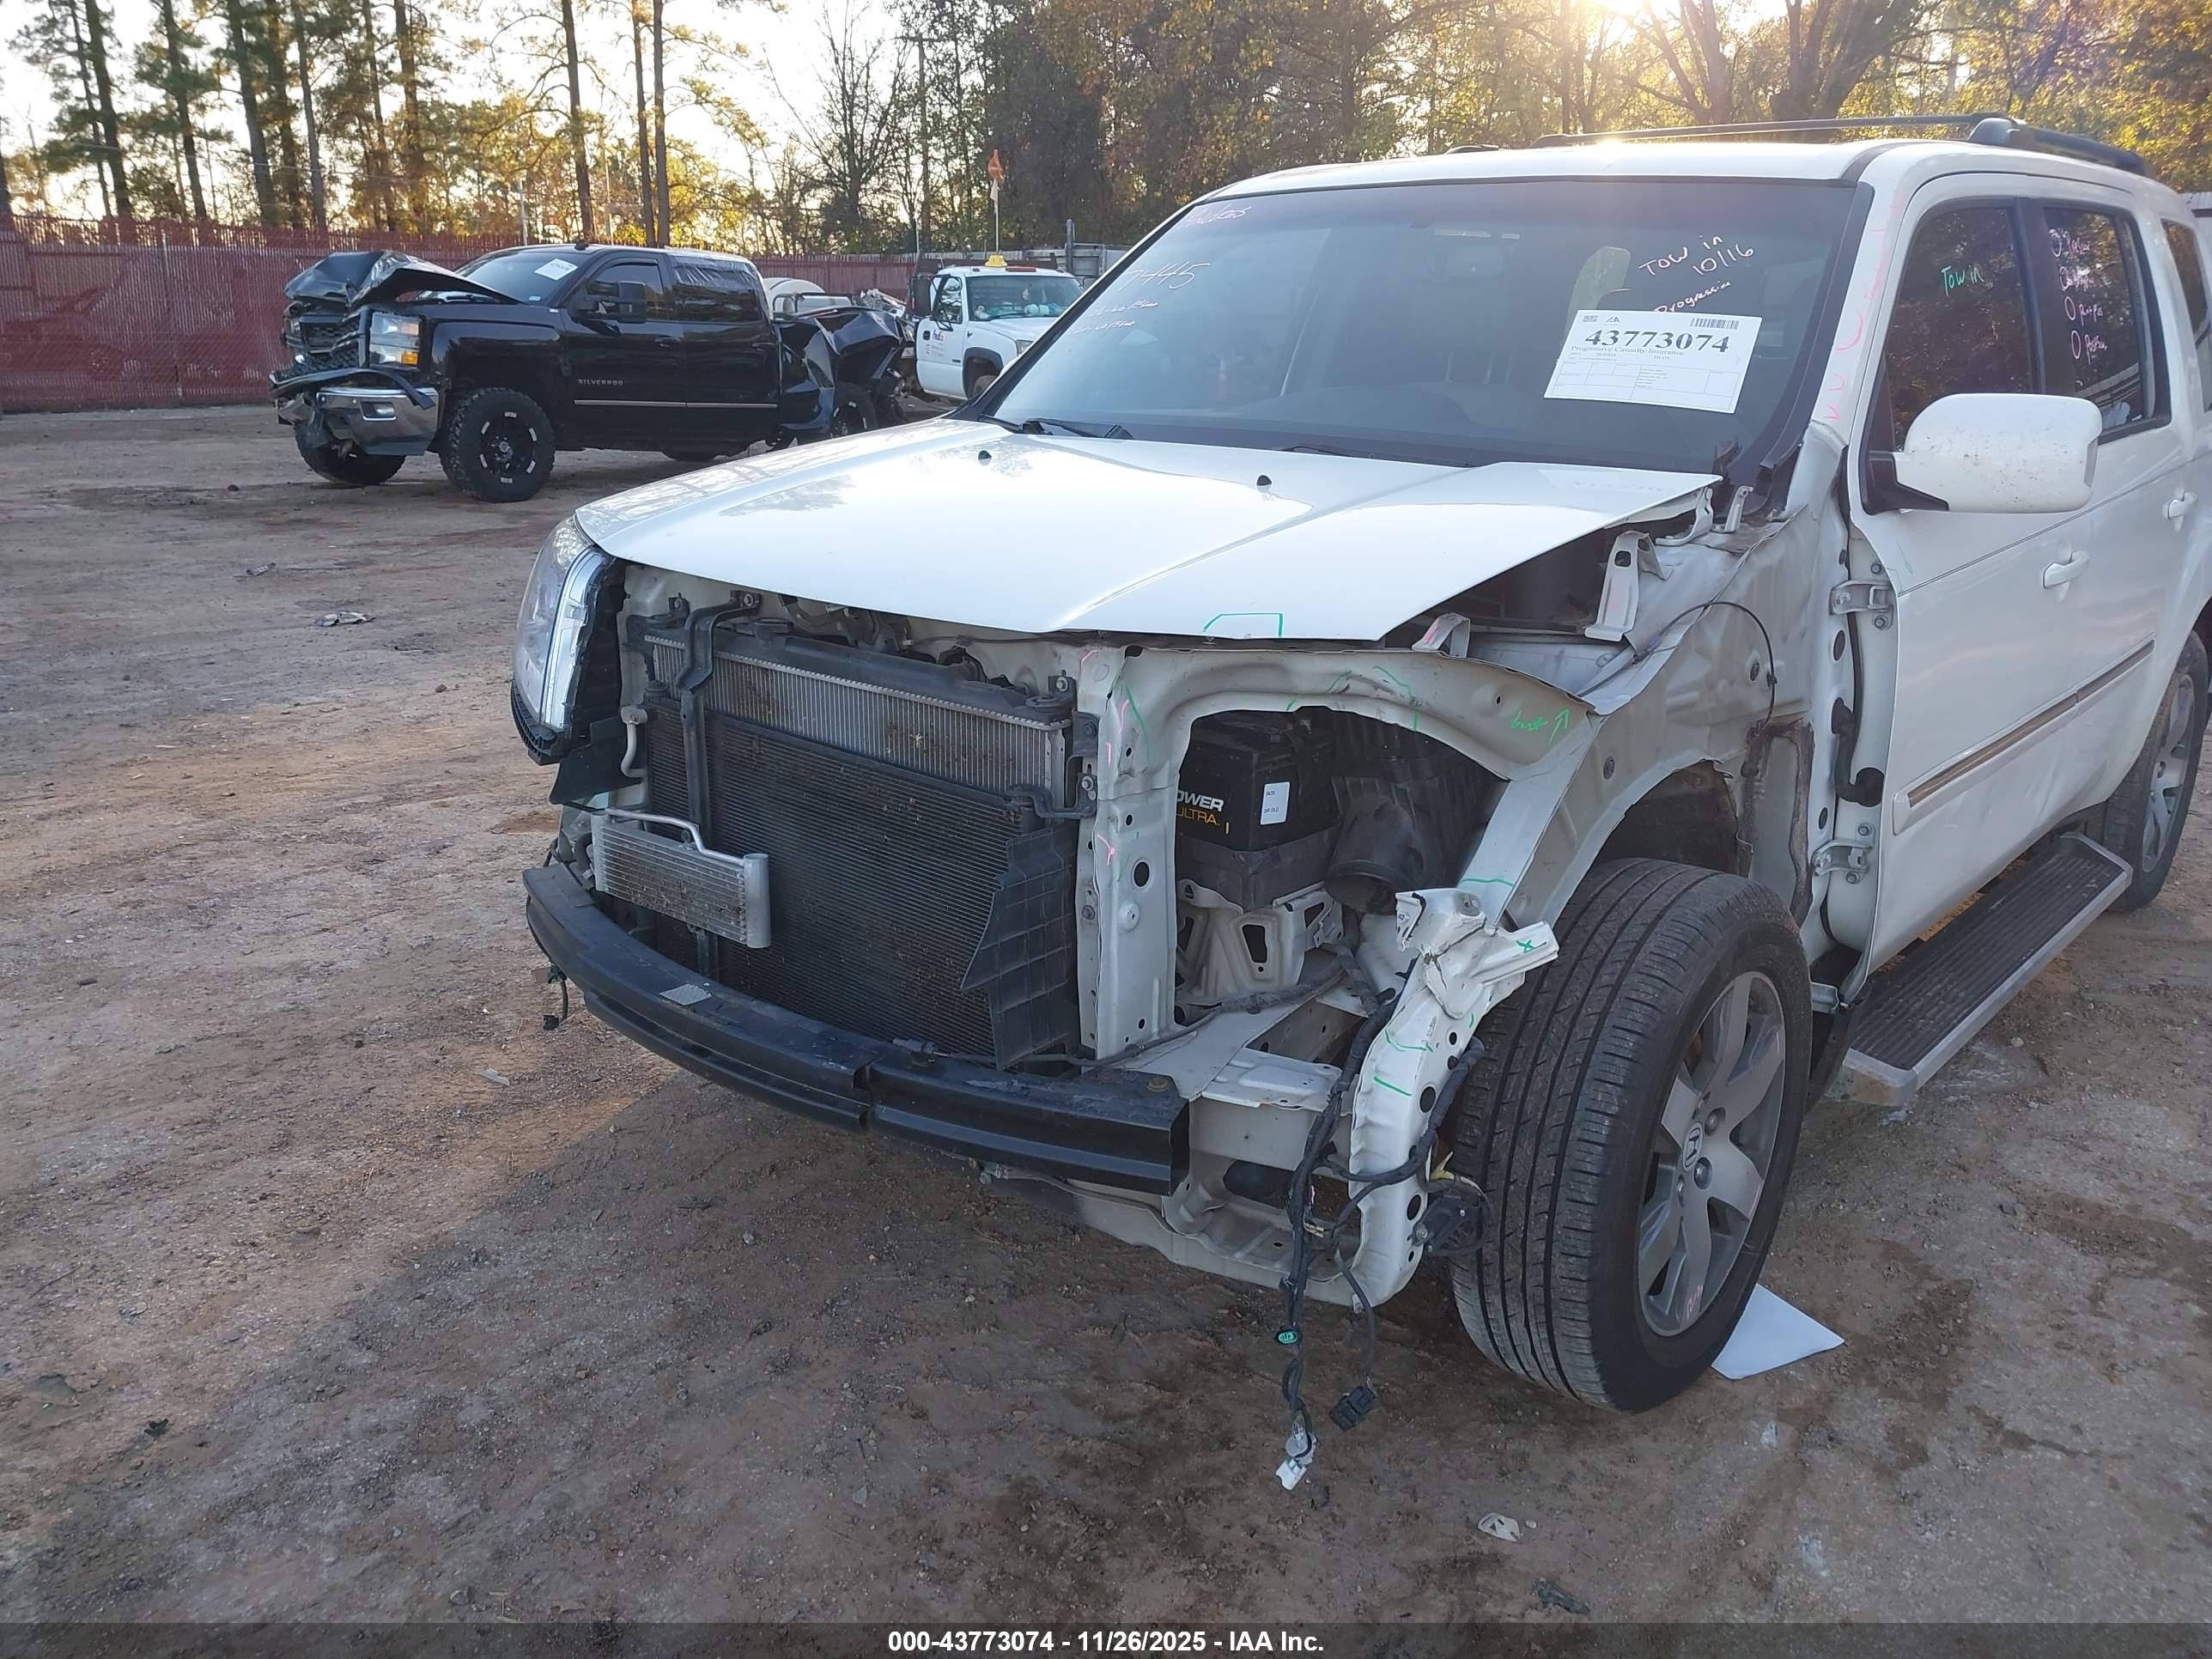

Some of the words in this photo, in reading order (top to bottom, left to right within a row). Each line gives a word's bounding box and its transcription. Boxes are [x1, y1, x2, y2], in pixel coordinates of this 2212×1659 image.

[1638, 246, 1688, 275] Tow
[1698, 234, 1723, 249] in
[1692, 243, 1753, 275] 10/16
[1941, 264, 1966, 296] Tow
[1968, 264, 1985, 284] in
[1584, 329, 1730, 353] 43773074
[1614, 346, 1645, 355] Casualty
[1649, 348, 1686, 356] Insurance
[1177, 790, 1224, 811] OWER
